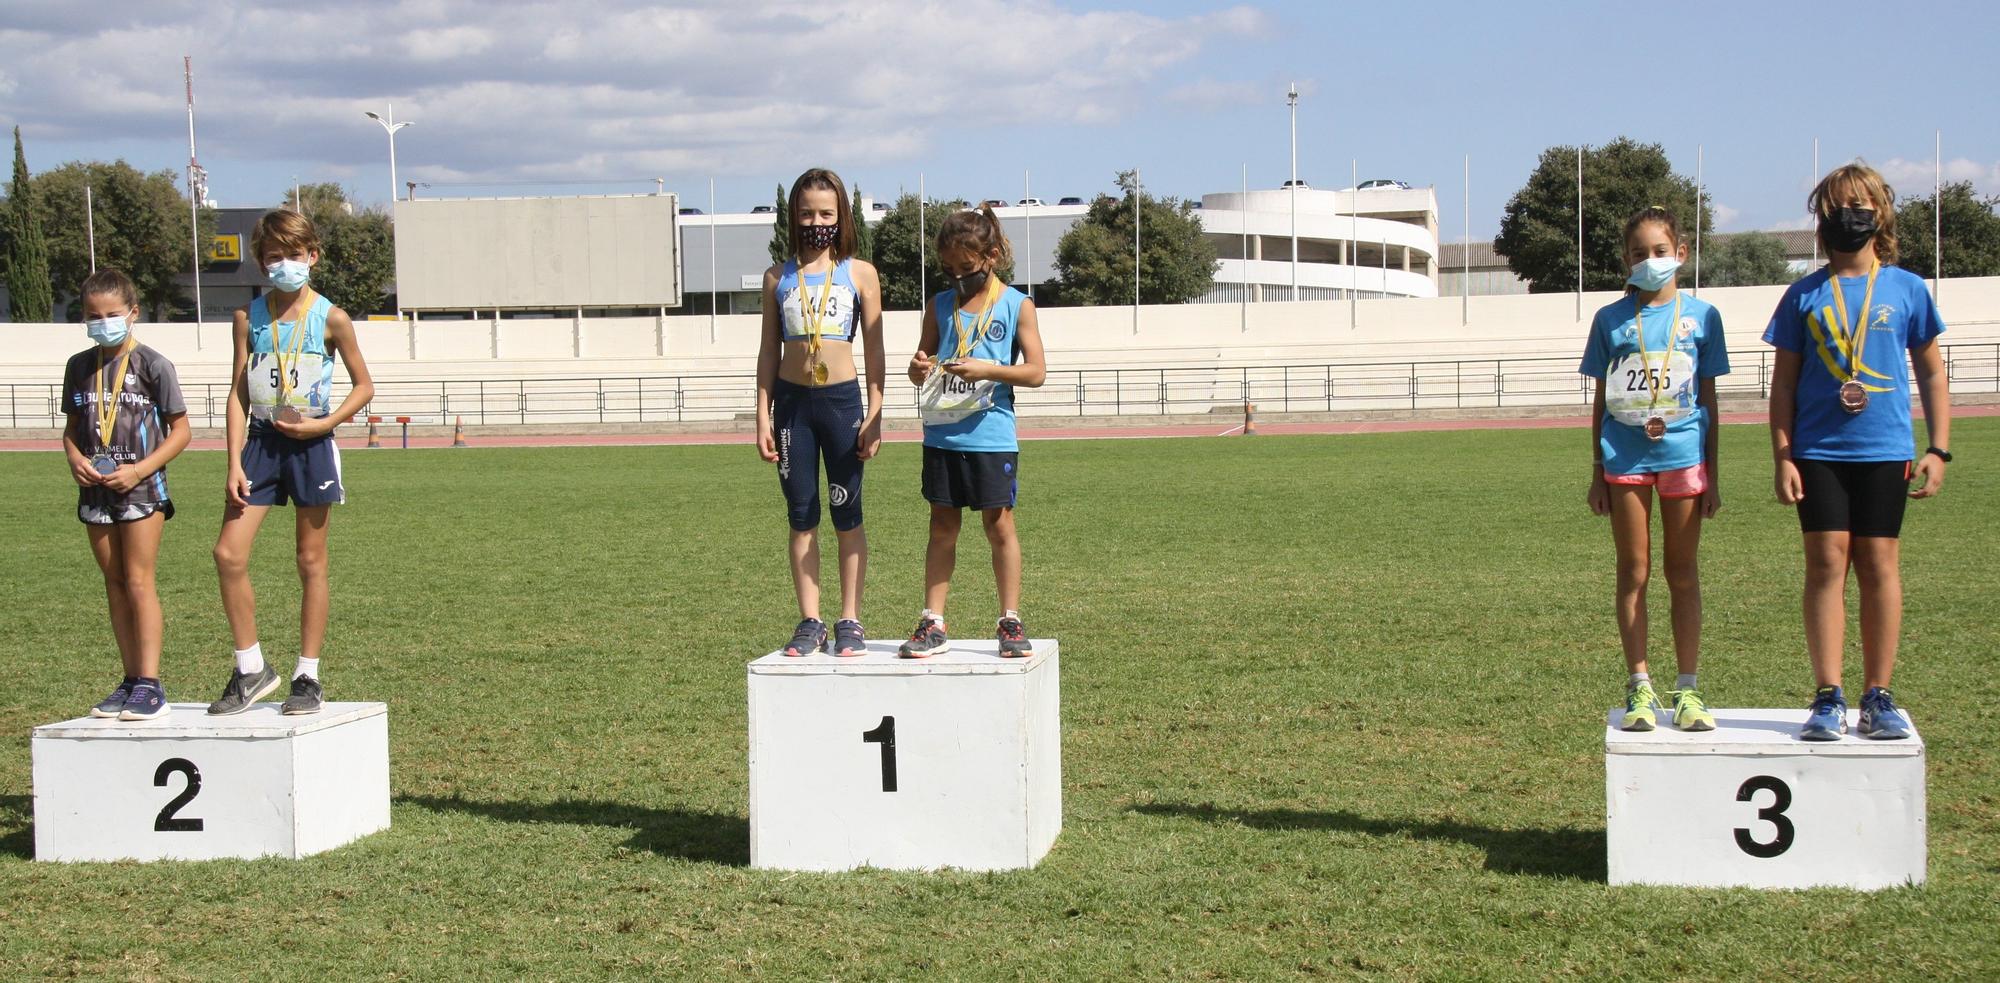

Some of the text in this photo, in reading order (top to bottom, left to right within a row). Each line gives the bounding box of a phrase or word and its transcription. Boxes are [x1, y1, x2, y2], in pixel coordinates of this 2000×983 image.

[780, 428, 790, 469] RUNNING
[863, 715, 898, 792] 1
[153, 757, 204, 832] 2
[1733, 775, 1795, 858] 3
